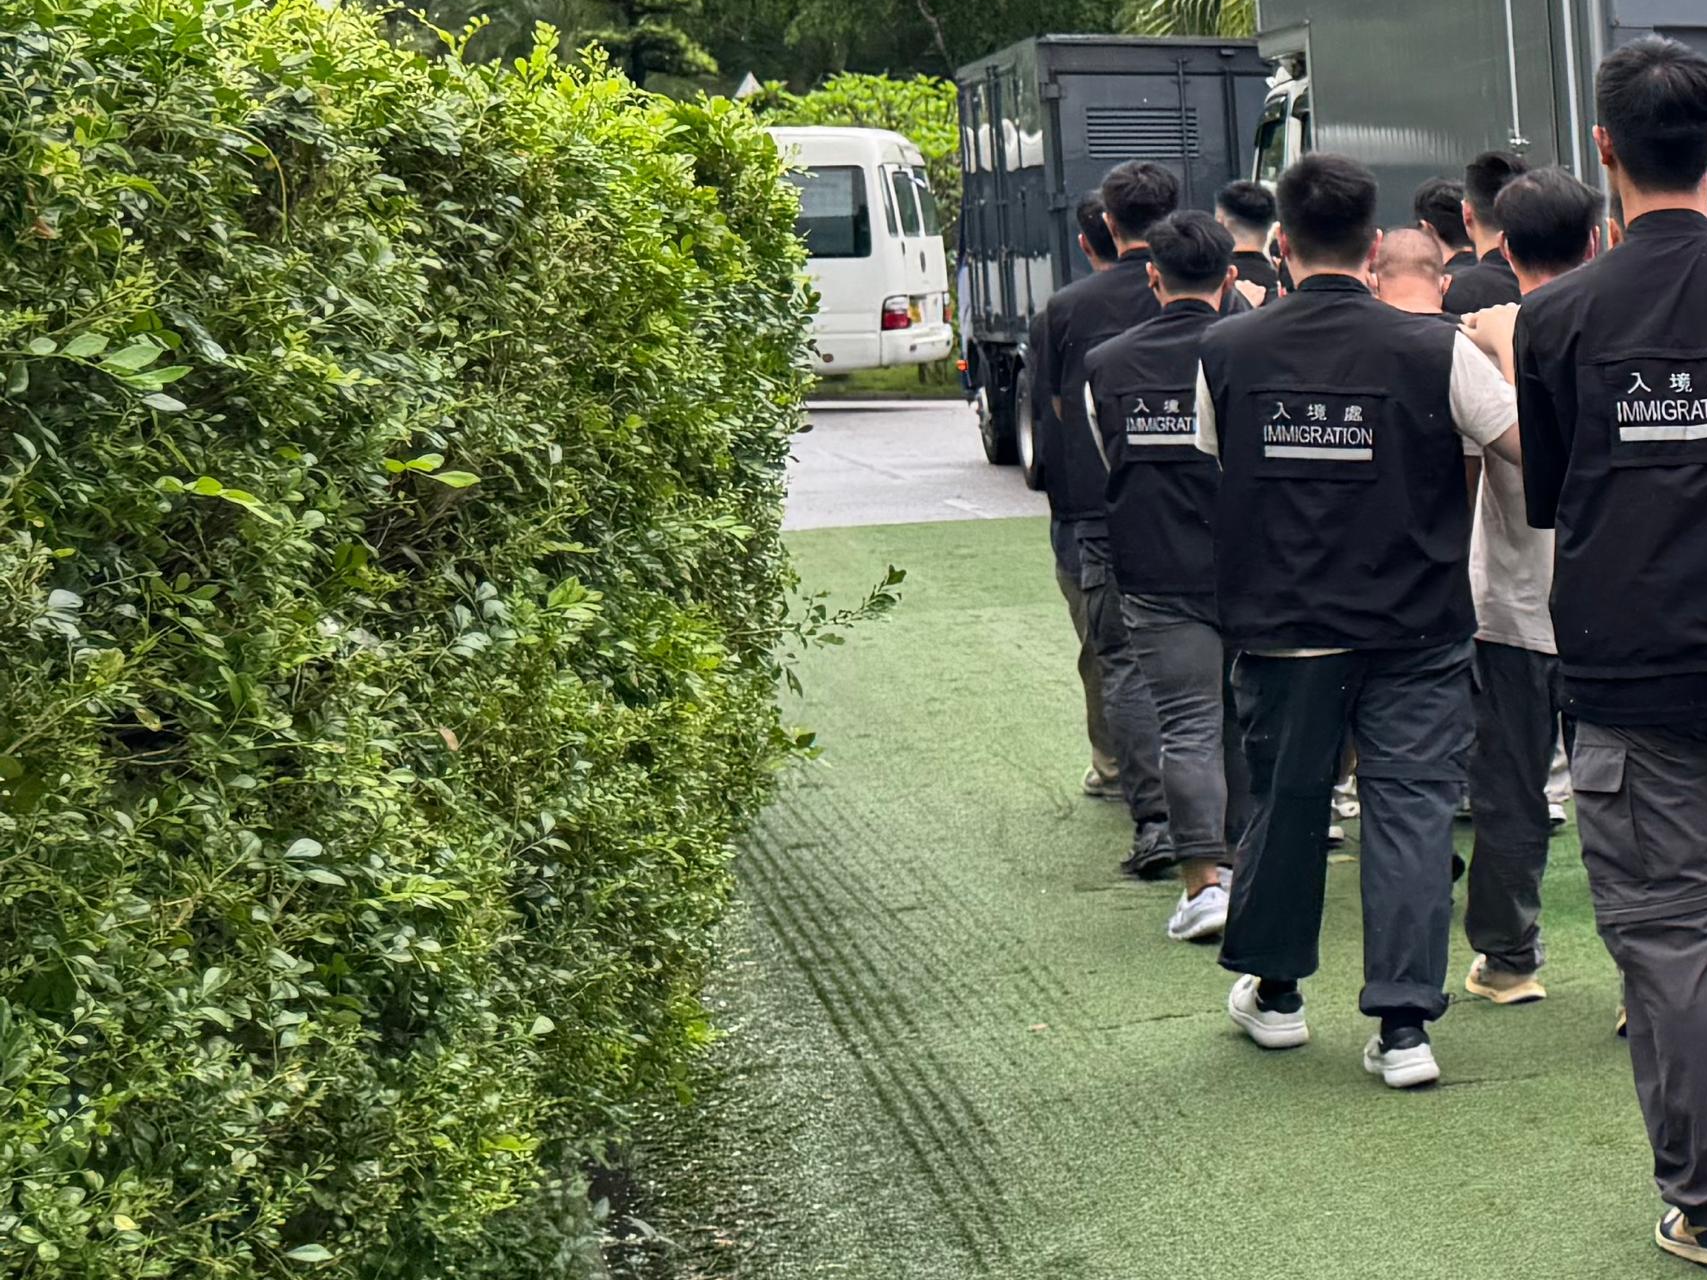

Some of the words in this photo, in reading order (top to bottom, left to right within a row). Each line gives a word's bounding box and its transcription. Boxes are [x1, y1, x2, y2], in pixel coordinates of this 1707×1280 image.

[1133, 398, 1197, 414] 入境
[1272, 401, 1363, 422] 入境處
[1263, 424, 1373, 445] IMMIGRATION
